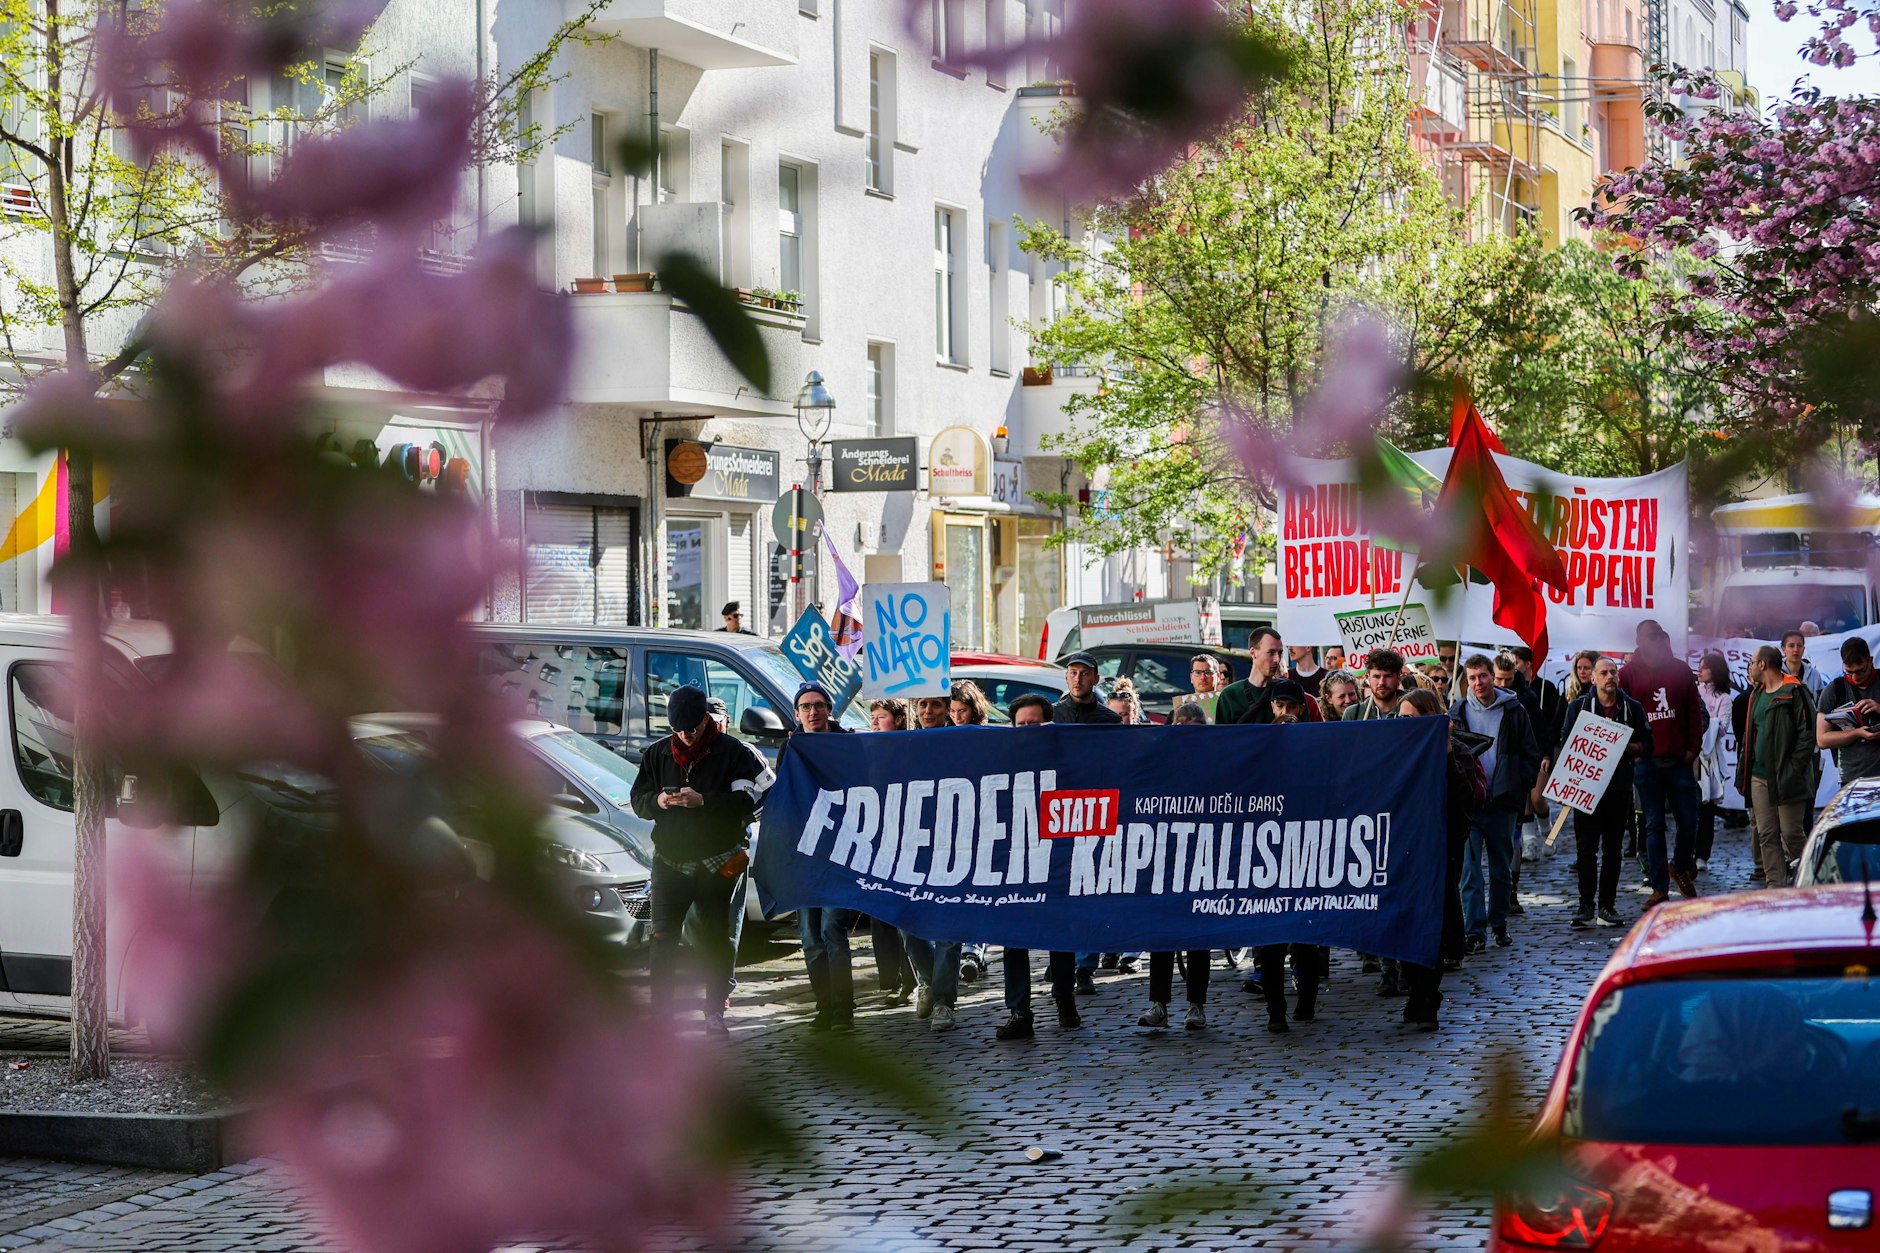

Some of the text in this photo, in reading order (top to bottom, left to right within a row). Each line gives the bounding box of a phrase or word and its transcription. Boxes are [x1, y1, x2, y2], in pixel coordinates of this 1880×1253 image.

[705, 452, 773, 476] erungsSchneiderei
[842, 448, 889, 460] Änderungs
[858, 454, 909, 467] Schneiderei
[713, 471, 749, 497] Moda
[851, 463, 907, 483] Moda
[1284, 540, 1403, 599] BEENDEN!
[875, 593, 927, 634] NO
[1086, 610, 1152, 624] Autoschlüssel
[1338, 612, 1411, 635] RÜSTUNGS-
[1126, 623, 1191, 634] Schlüsseldienst
[866, 611, 950, 693] NATO!
[1647, 710, 1676, 722] BERLIN
[1583, 722, 1624, 744] GEGEN
[1570, 734, 1608, 762] KRIEG
[1563, 754, 1604, 782] KRISE
[1135, 796, 1204, 815] KAPITALIZM
[1248, 795, 1285, 816] BARIŞ
[1546, 778, 1596, 811] KAPITAL
[1048, 796, 1110, 834] STATT
[797, 769, 1057, 887] FRIEDEN
[1069, 812, 1391, 897] KAPITALISMUS!
[1192, 894, 1235, 916] POKÓJ
[1237, 896, 1293, 915] ZAMIAST
